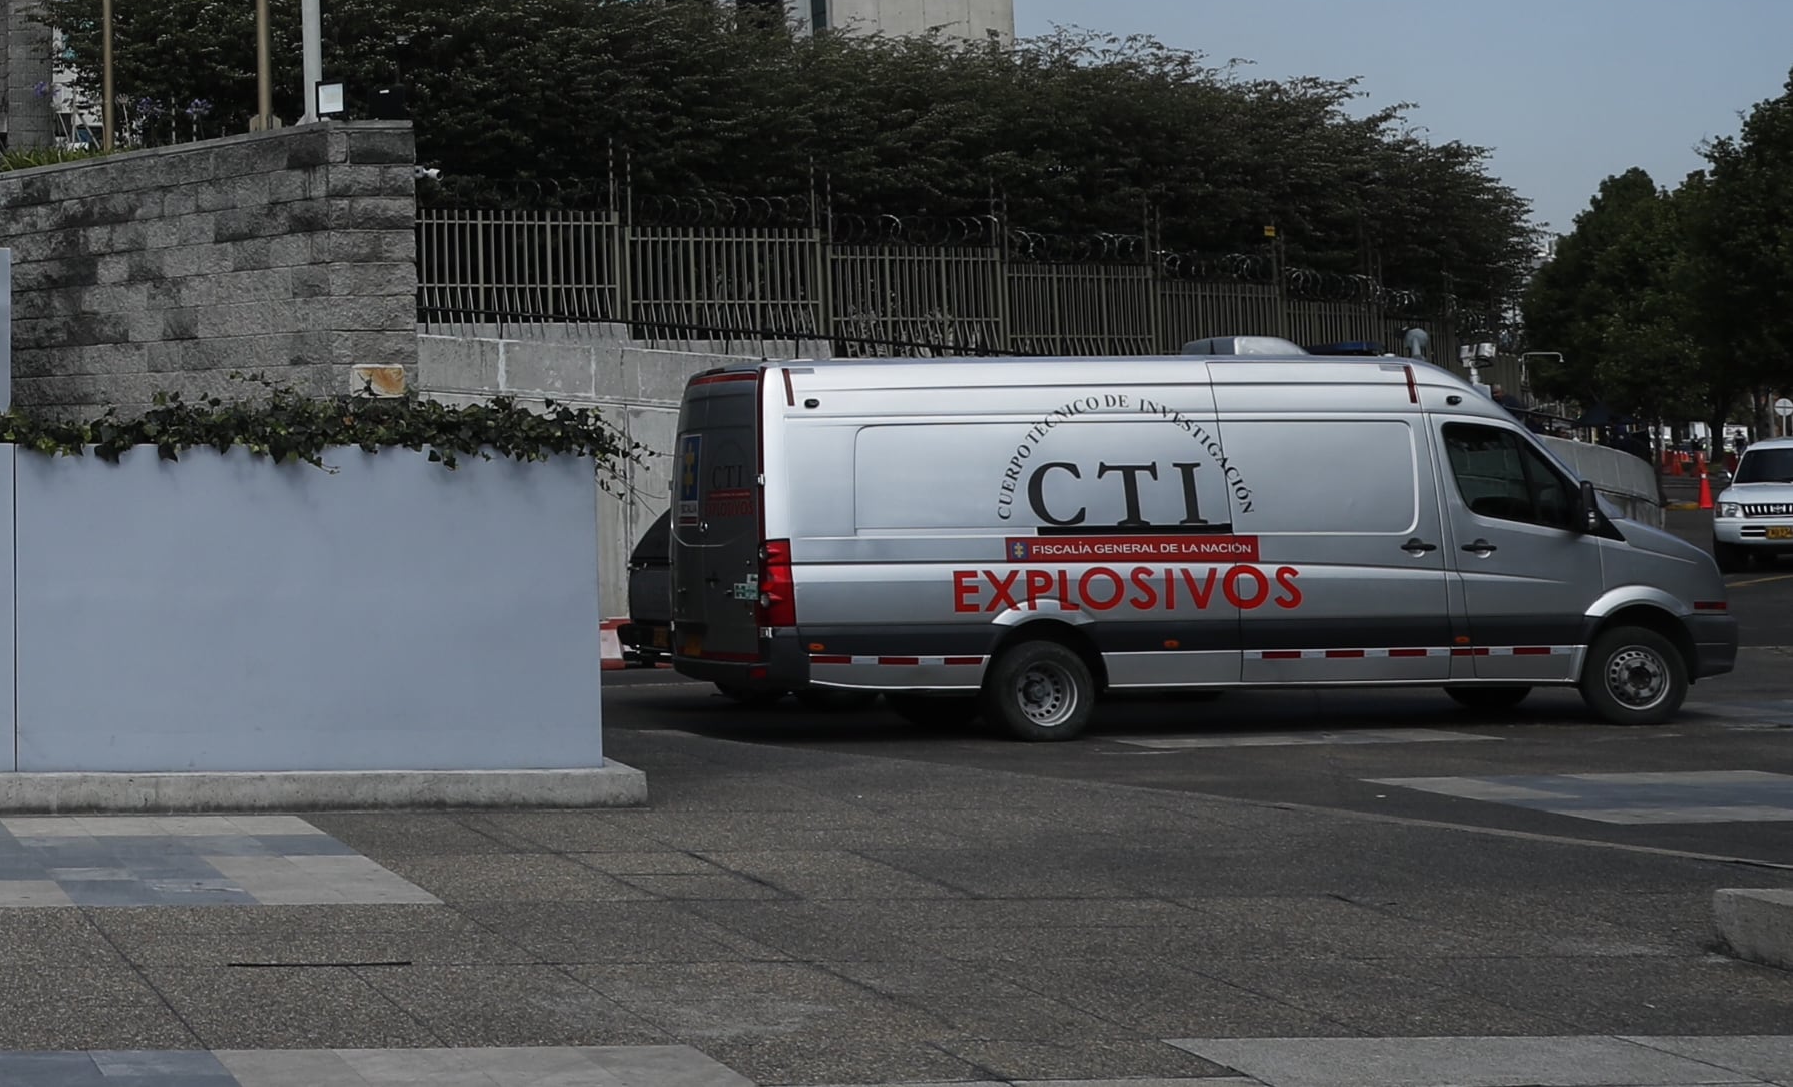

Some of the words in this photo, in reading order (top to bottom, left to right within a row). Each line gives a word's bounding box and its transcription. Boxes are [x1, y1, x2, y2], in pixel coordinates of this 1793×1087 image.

[712, 465, 743, 490] CTI
[997, 443, 1031, 521] CUERPO
[1105, 394, 1130, 408] DE
[1139, 398, 1255, 515] INVESTIGACIÓN
[1027, 462, 1209, 526] CTI
[1033, 541, 1092, 555] FISCALÍA
[1095, 543, 1158, 555] GENERAL
[1160, 543, 1178, 554] DE
[1181, 543, 1202, 554] LA
[1204, 542, 1252, 554] NACIÓN
[952, 564, 1303, 613] EXPLOSIVOS
